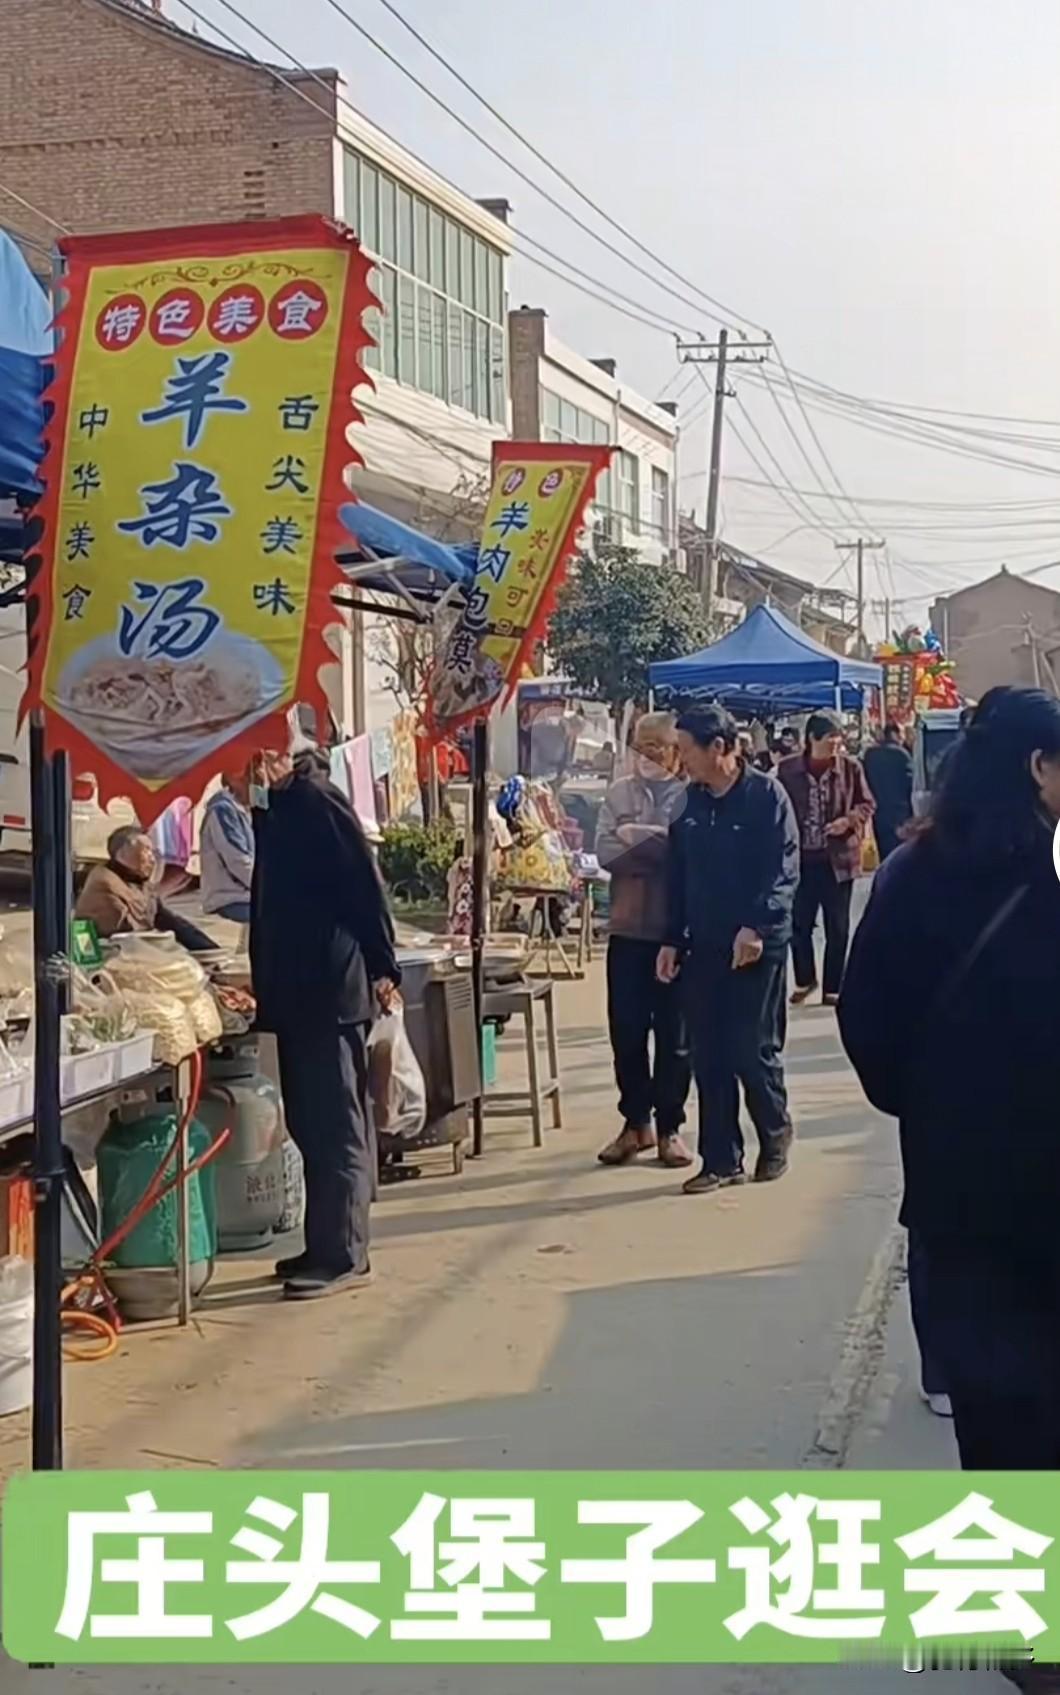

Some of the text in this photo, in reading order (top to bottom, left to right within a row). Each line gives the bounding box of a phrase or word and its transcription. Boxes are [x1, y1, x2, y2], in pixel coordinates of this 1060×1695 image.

[102, 292, 323, 343] 特色美食
[61, 402, 109, 620] 中华美食
[117, 351, 247, 660] 羊杂汤
[252, 395, 319, 615] 舌尖美味
